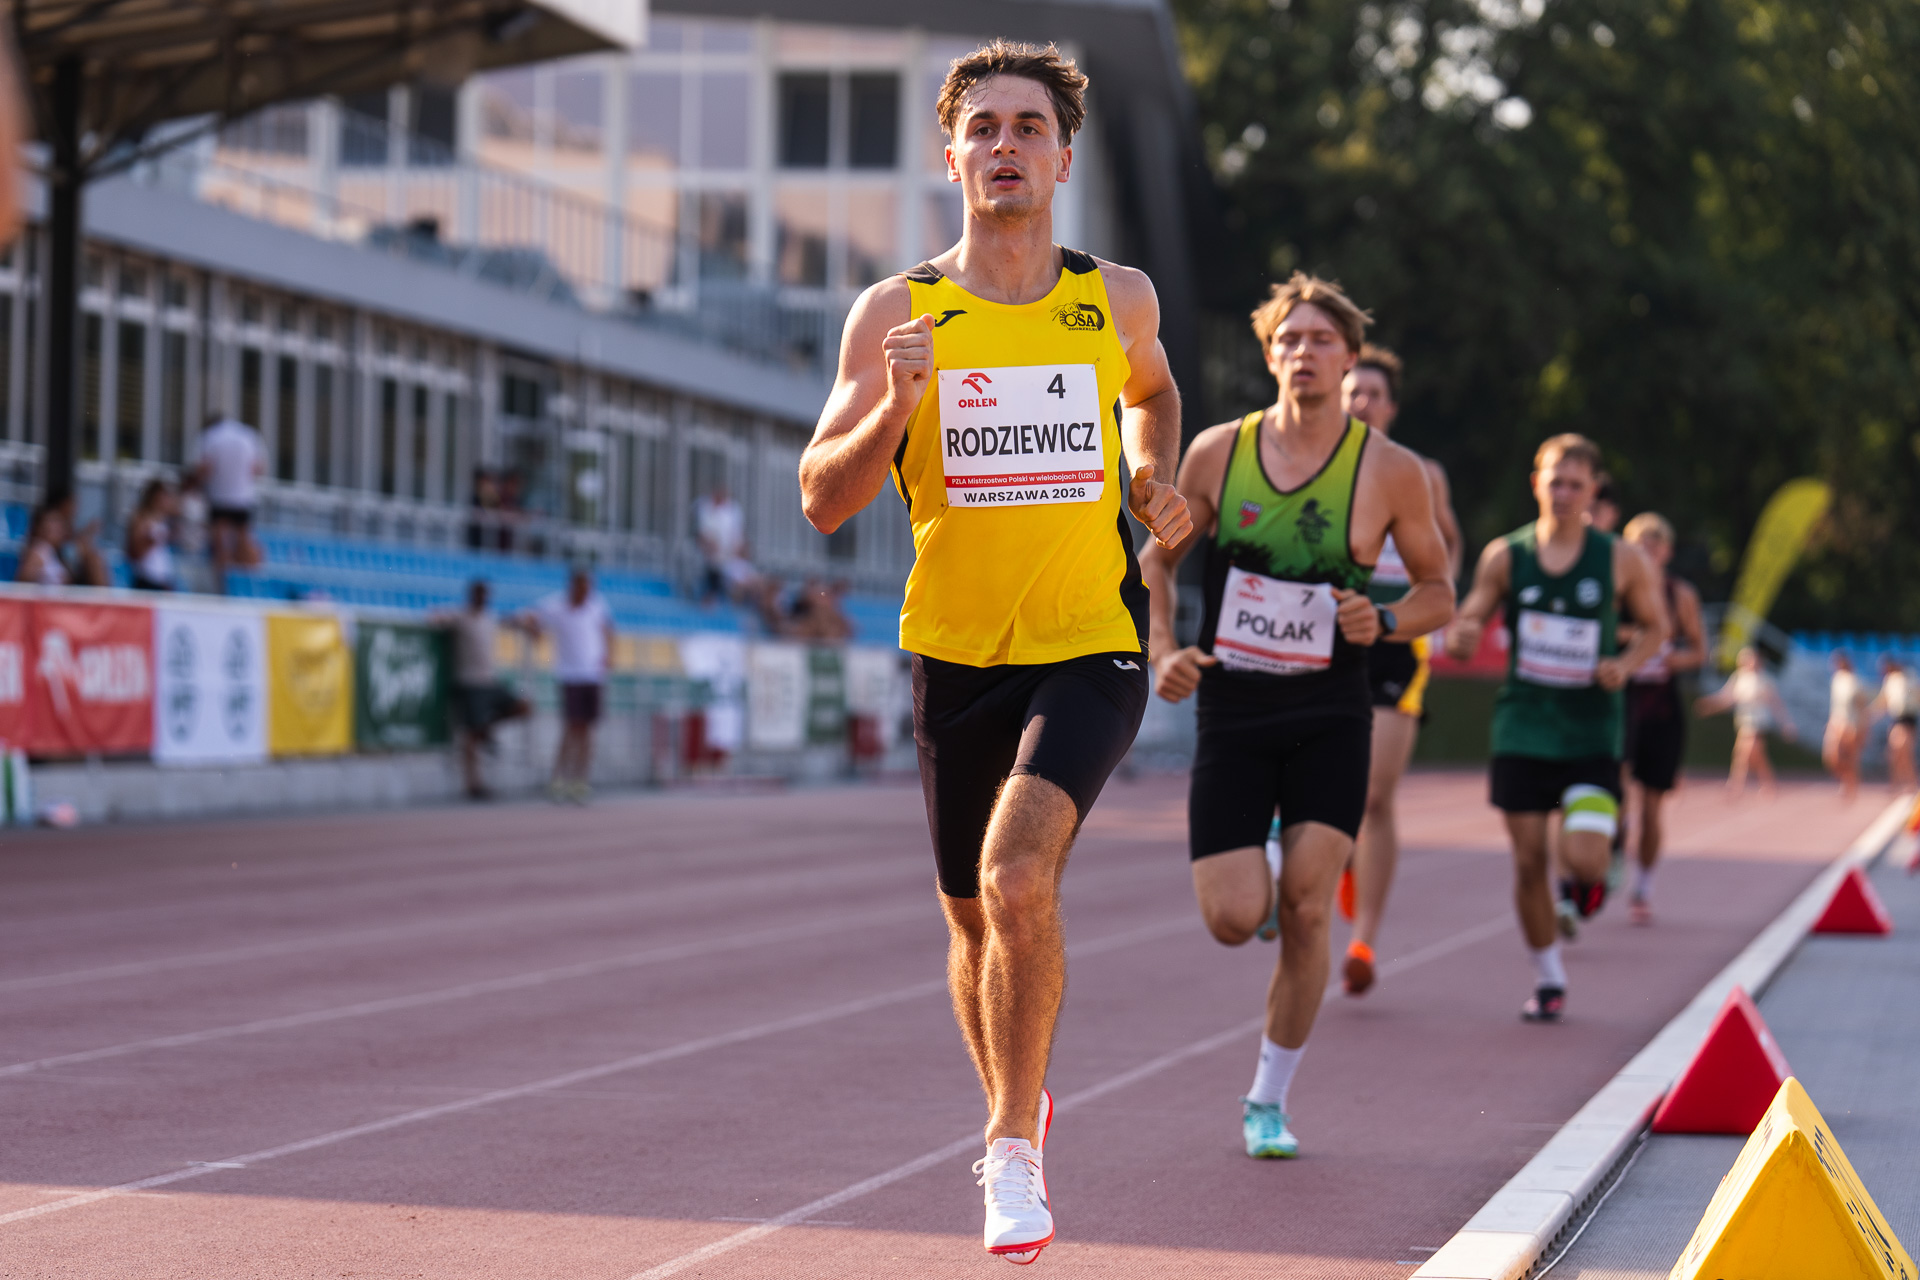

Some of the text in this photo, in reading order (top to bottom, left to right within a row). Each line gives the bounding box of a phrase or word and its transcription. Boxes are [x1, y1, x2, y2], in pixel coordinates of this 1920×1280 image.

[1064, 313, 1096, 327] OSA
[1046, 373, 1066, 399] 4
[958, 397, 998, 409] ORLEN
[946, 422, 1097, 458] RODZIEWICZ
[951, 477, 967, 485] PZLA
[967, 476, 1008, 485] Mistrzostwa
[1008, 474, 1028, 483] Polski
[1036, 473, 1077, 483] wielobojach
[1078, 471, 1097, 480] (U20)
[964, 487, 1086, 503] WARSZAWA 2026
[1301, 589, 1315, 608] 7
[1235, 610, 1317, 642] POLAK
